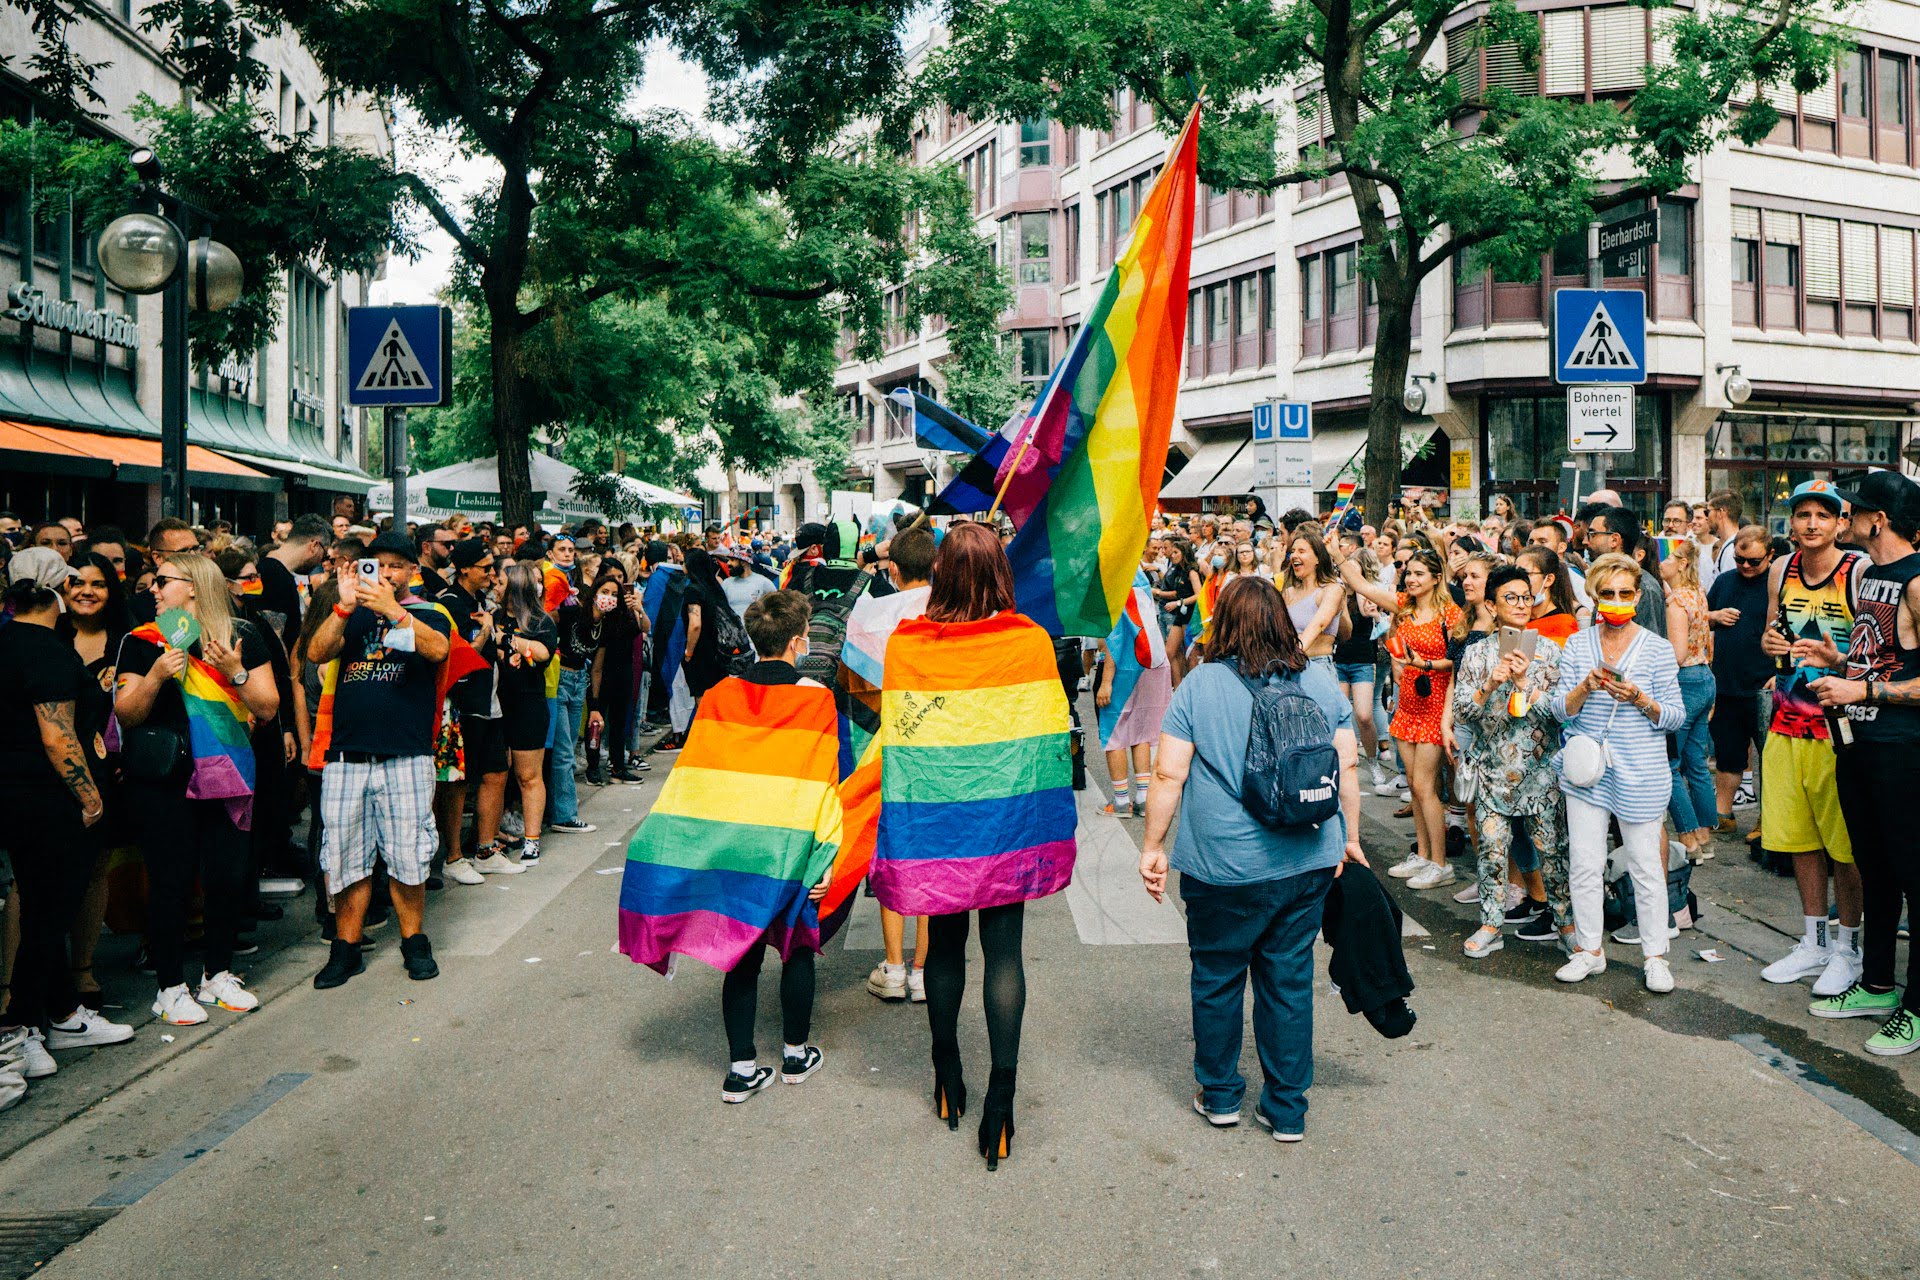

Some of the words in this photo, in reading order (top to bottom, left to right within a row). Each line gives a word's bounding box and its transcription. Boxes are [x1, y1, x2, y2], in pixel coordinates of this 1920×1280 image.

[1600, 221, 1653, 251] Eberhardstr.
[1574, 391, 1628, 403] Bohnen-
[1257, 407, 1270, 431] U
[1284, 406, 1304, 430] U
[1581, 406, 1622, 417] viertel
[376, 662, 406, 672] LOVE
[343, 670, 370, 683] LESS
[893, 700, 918, 736] Xenia
[1299, 785, 1333, 803] PUMA
